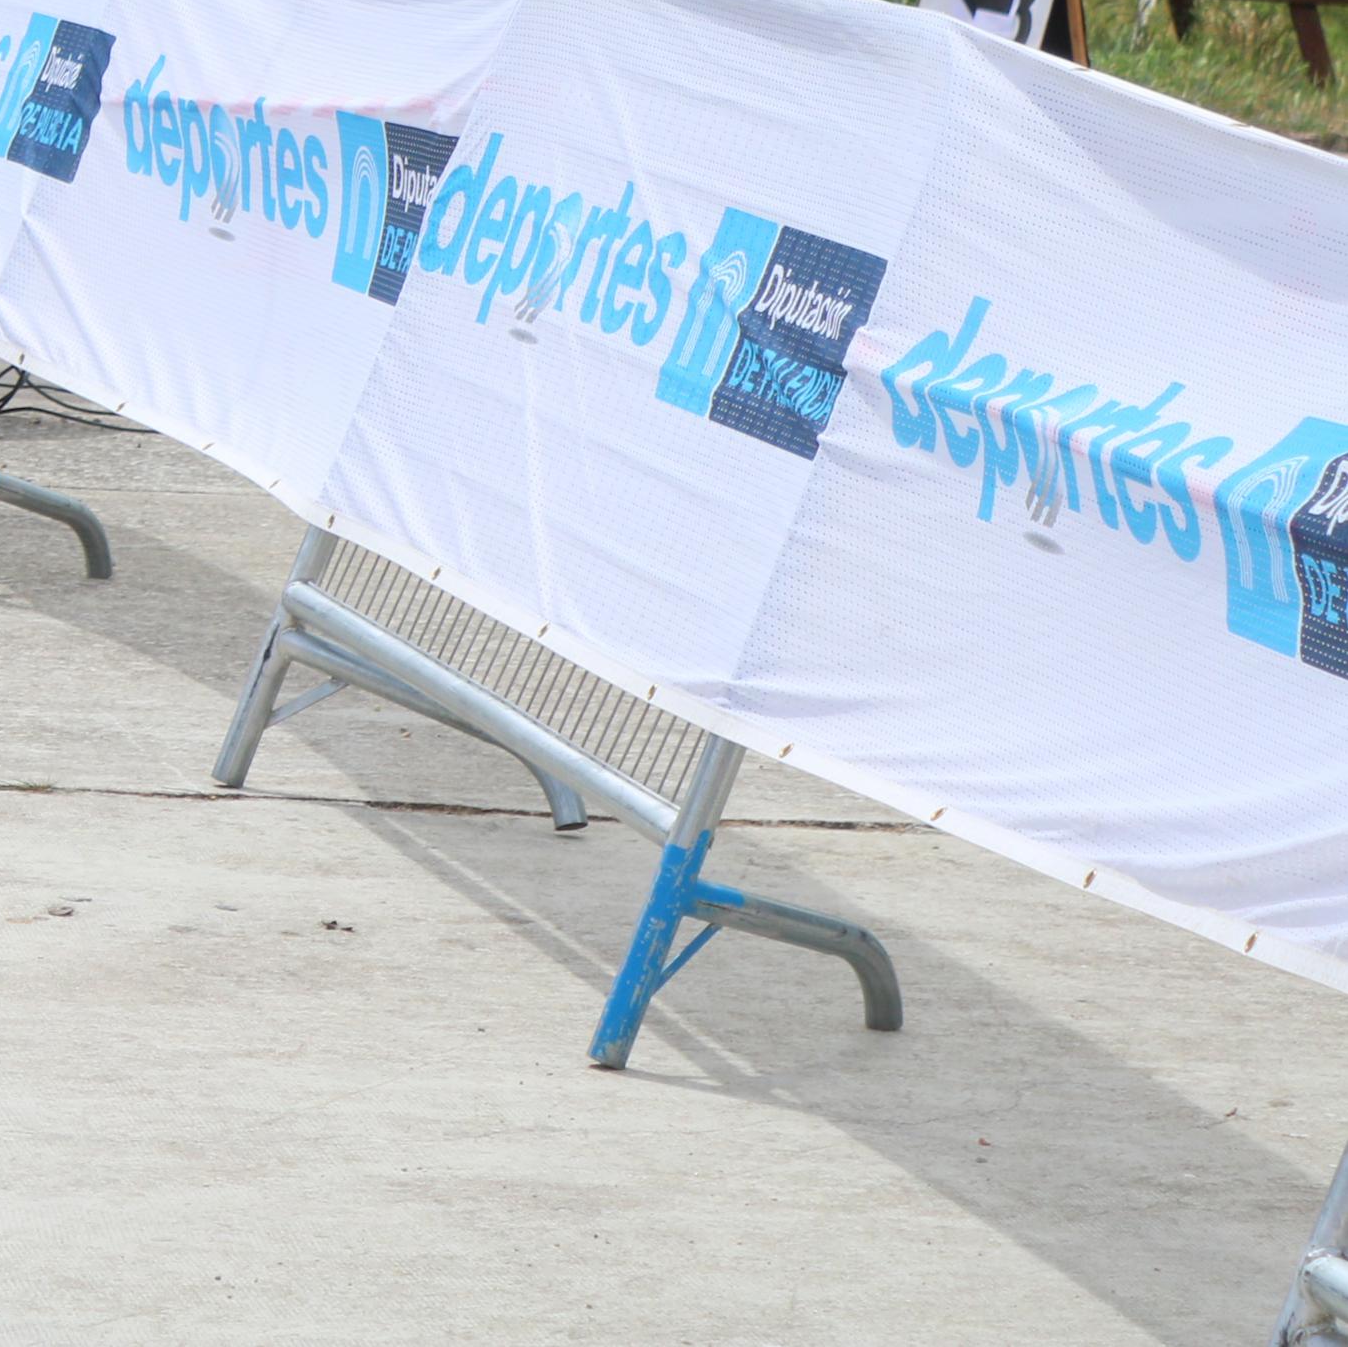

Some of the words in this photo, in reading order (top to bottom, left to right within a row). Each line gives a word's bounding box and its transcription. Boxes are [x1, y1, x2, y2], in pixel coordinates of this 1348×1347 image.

[123, 54, 328, 239] deportes
[415, 132, 687, 347] deportes
[728, 337, 761, 393] DE
[881, 295, 1235, 563] deportes
